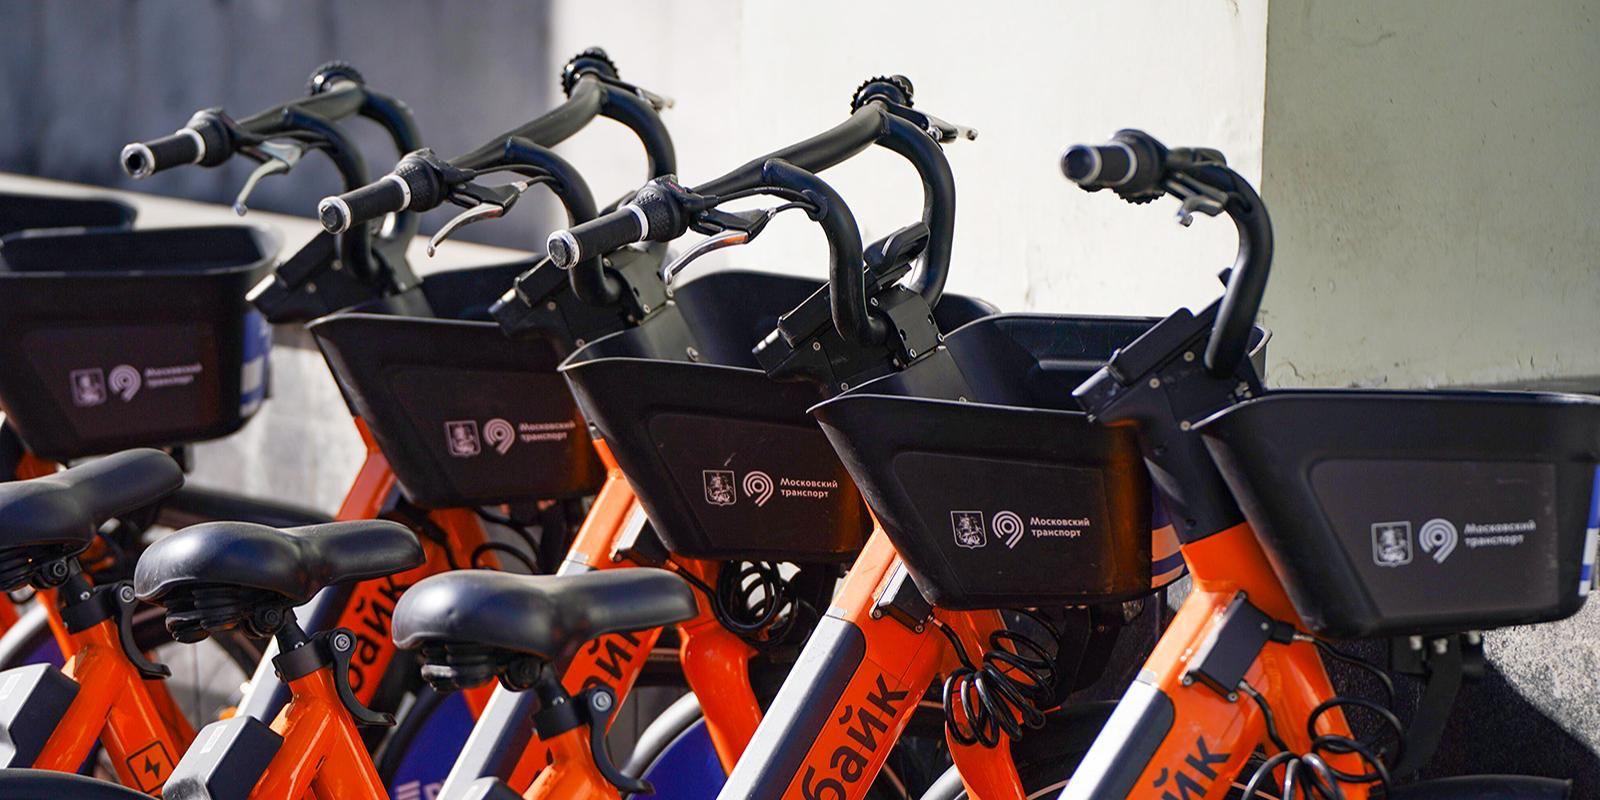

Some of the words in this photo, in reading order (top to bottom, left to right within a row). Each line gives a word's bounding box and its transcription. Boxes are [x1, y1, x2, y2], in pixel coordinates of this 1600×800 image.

[520, 420, 576, 431] Московский
[521, 432, 568, 443] транспорт
[780, 477, 838, 489] Московский
[781, 489, 829, 499] транспорт
[1030, 516, 1090, 527] Московский
[1464, 520, 1537, 534] Московский
[1031, 528, 1081, 539] транспорт
[1464, 534, 1524, 549] транспорт
[802, 673, 910, 800] байк
